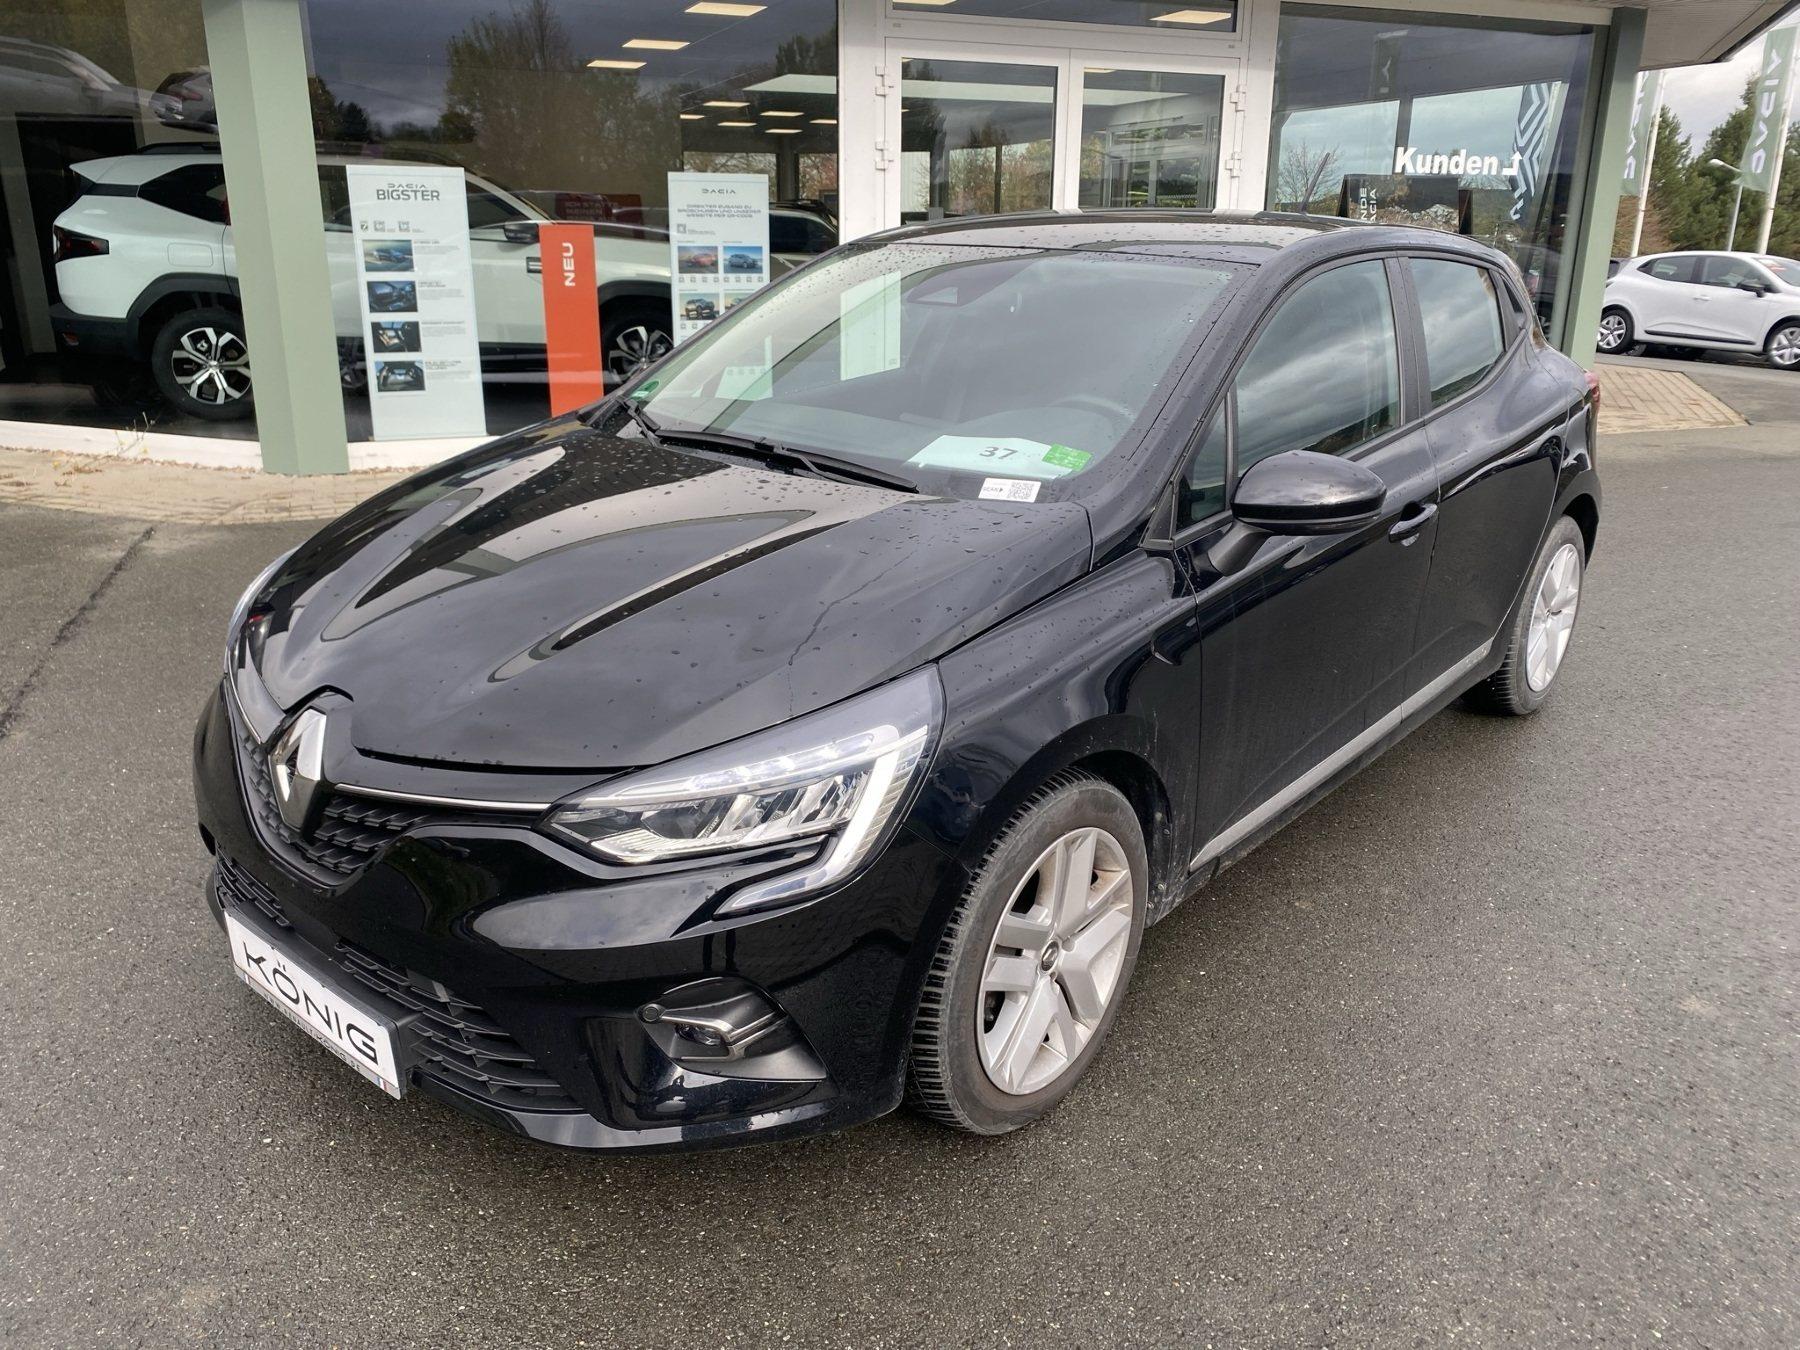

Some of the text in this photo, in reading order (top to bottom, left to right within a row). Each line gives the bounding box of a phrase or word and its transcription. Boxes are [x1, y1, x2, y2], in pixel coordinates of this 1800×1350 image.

[1394, 146, 1498, 176] Kunden
[376, 189, 440, 201] BIGSTER
[1360, 187, 1368, 220] NDE
[1369, 188, 1377, 222] ACIA
[564, 242, 576, 287] NEU
[979, 446, 1019, 460] 37
[243, 941, 380, 1066] KÖNIG
